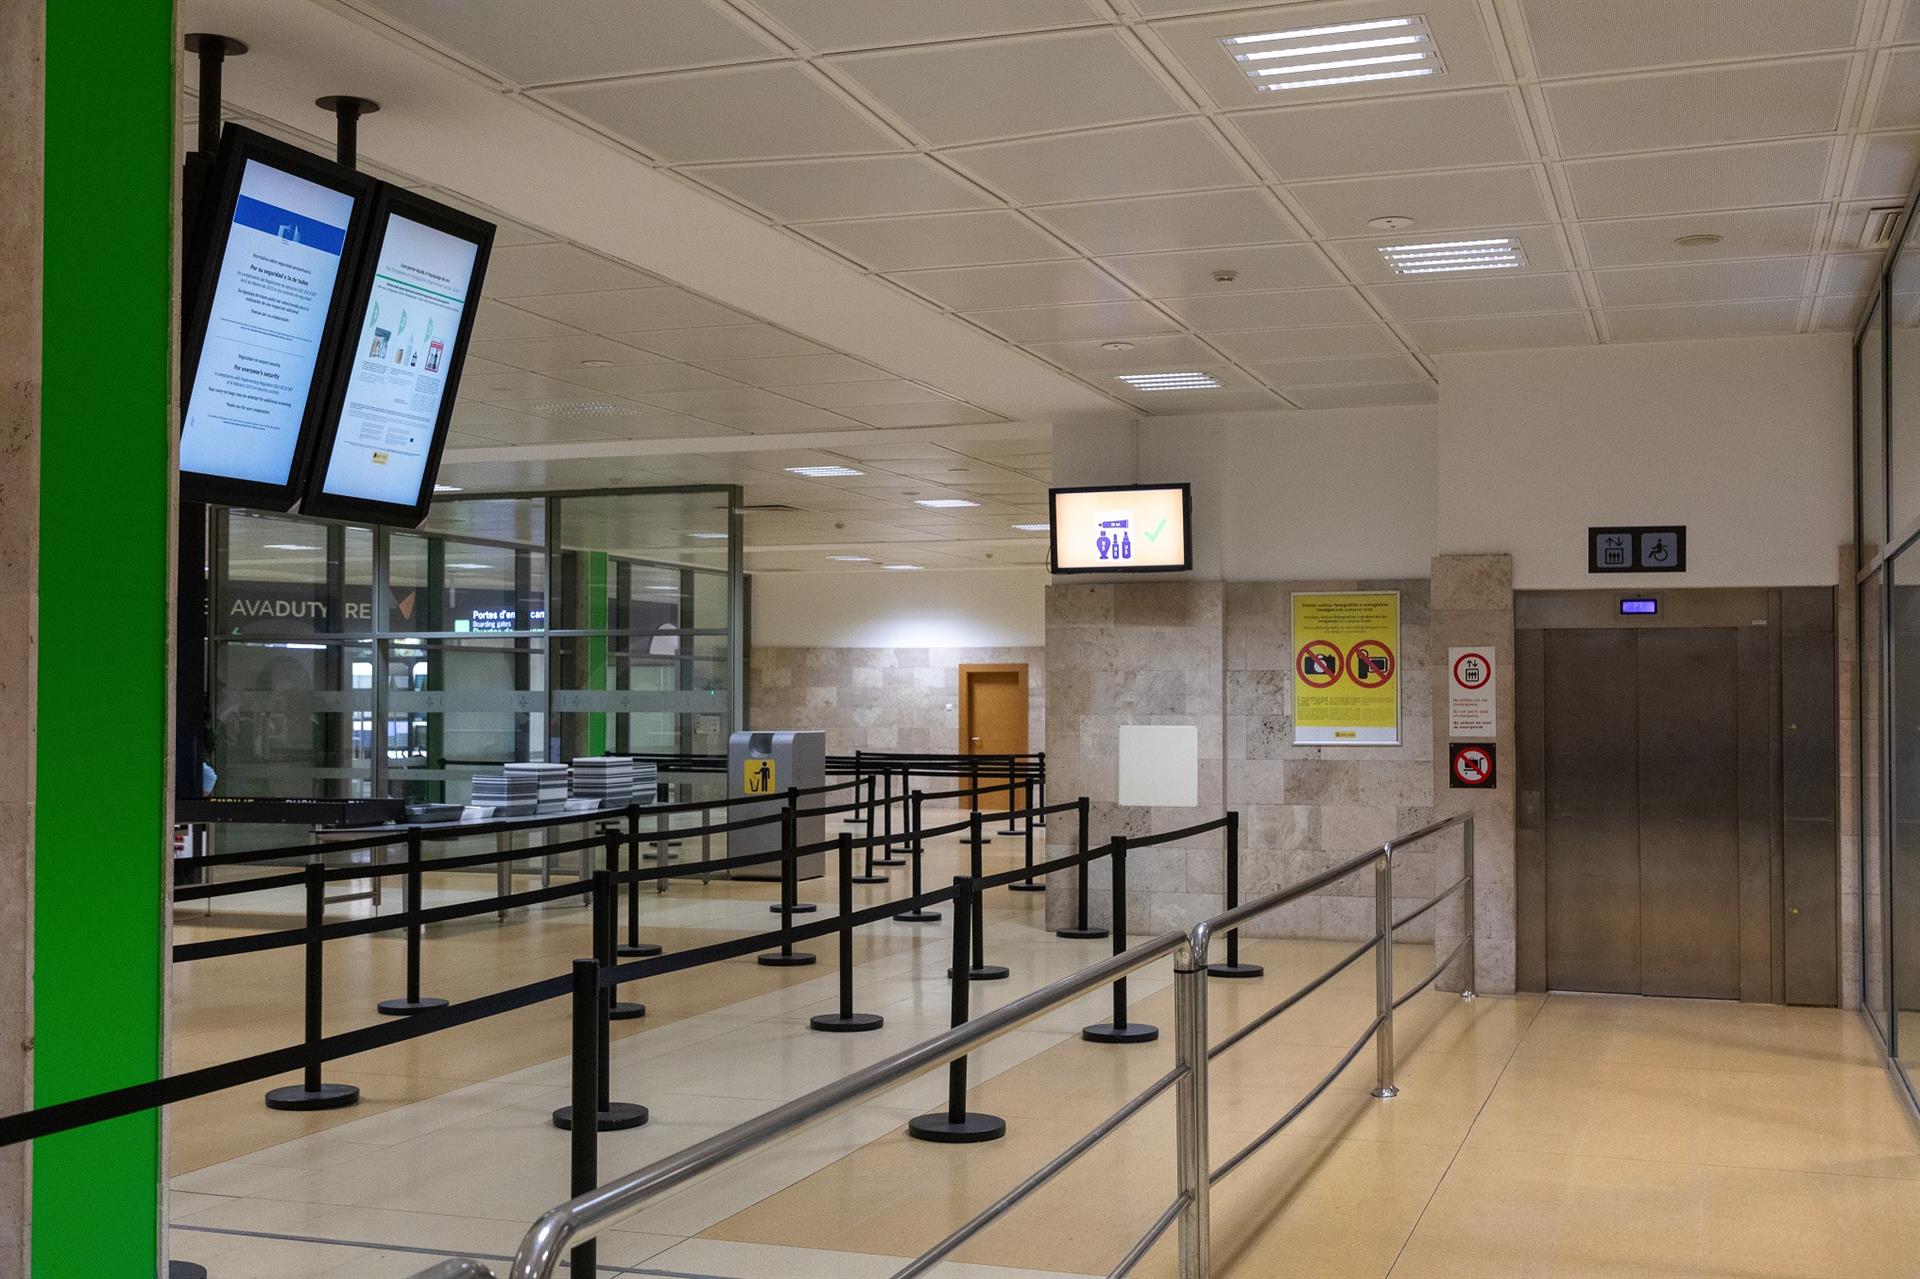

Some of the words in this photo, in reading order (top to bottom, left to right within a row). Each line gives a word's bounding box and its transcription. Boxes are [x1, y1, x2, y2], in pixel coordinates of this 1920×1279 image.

[264, 267, 284, 279] seguridad
[298, 277, 309, 286] todos
[242, 365, 263, 376] everyone's
[264, 370, 280, 380] security
[472, 610, 497, 619] Portes
